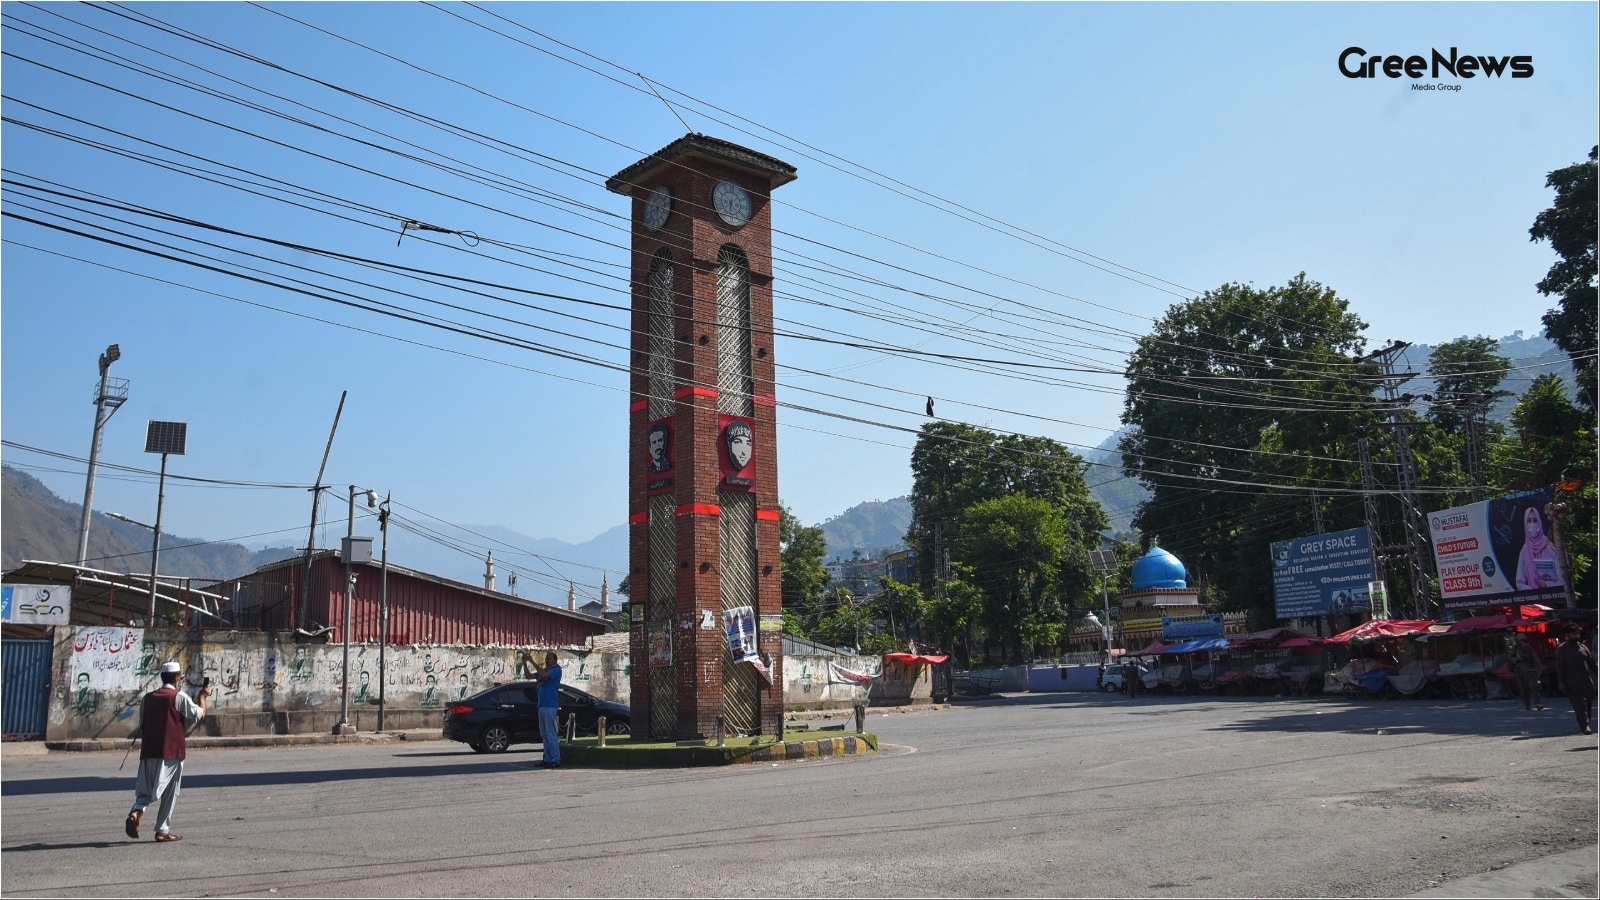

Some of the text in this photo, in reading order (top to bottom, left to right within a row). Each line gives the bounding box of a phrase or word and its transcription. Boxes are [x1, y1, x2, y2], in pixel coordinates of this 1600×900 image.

[1441, 513, 1469, 526] MUSTAFAI
[1300, 535, 1357, 554] GREY SPACE
[1437, 543, 1457, 553] CHILD'S
[1457, 540, 1477, 550] FUTURE
[1287, 565, 1304, 574] FREE
[1441, 567, 1456, 577] PLAY
[1457, 563, 1480, 575] GROUP
[1444, 578, 1467, 590] CLASS
[1467, 576, 1481, 588] 9th
[328, 659, 365, 672] DALY
